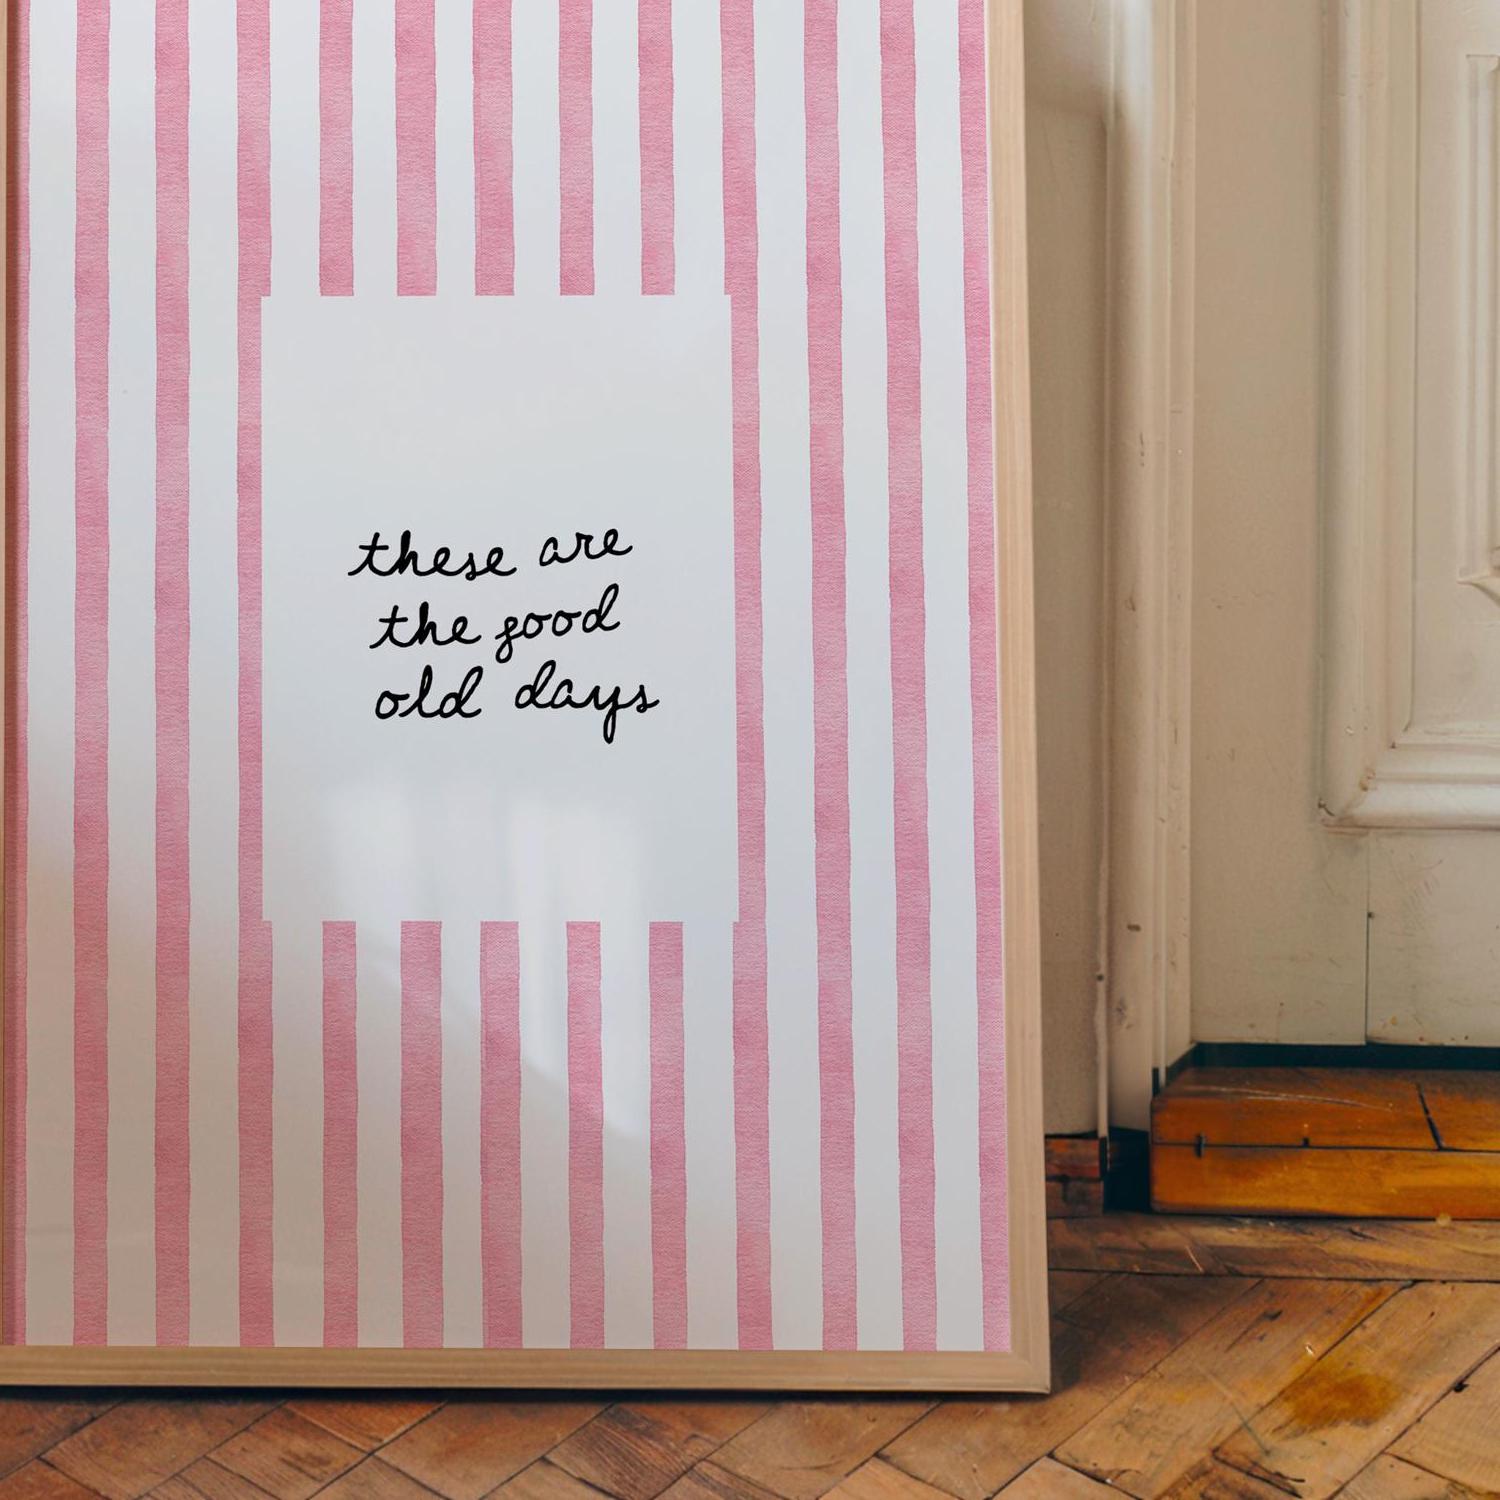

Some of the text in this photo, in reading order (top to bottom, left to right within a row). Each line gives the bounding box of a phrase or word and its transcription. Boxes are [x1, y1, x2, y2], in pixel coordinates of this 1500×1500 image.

[347, 528, 634, 582] these are
[369, 582, 621, 664] the good
[374, 659, 661, 745] old days
